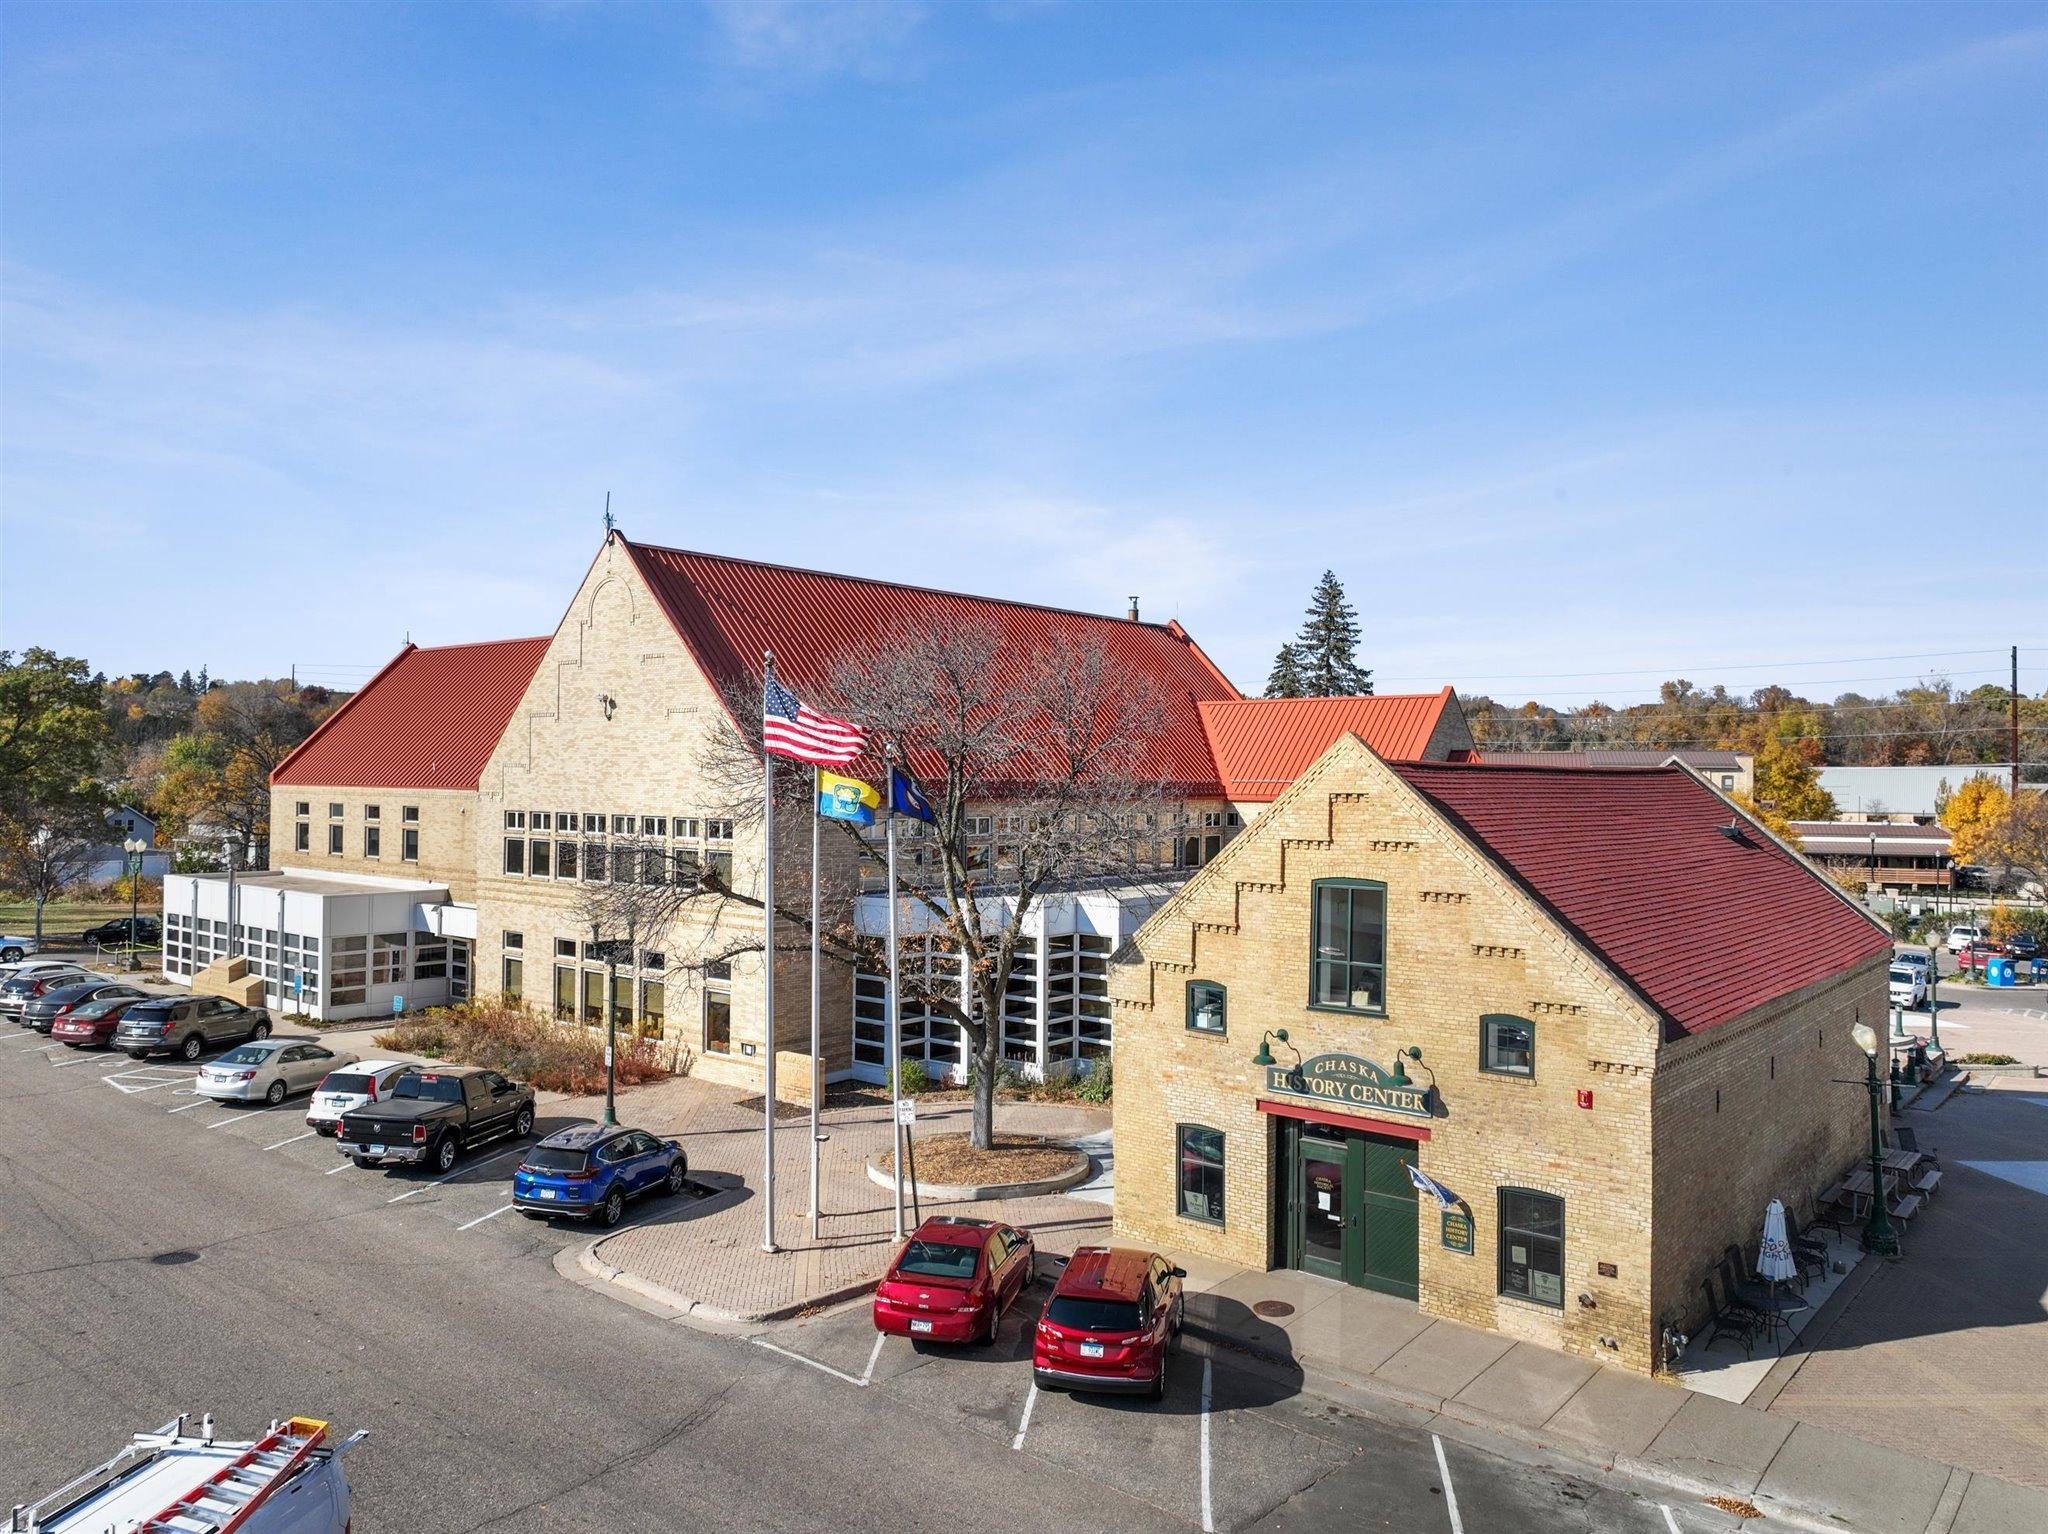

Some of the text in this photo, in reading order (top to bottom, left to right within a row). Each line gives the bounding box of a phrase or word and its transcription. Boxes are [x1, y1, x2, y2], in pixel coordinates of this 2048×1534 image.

[1315, 1060, 1379, 1083] CHASKA
[1272, 1072, 1427, 1112] HISTORY CENTER
[1446, 1220, 1467, 1230] CHASKA
[1445, 1233, 1468, 1243] CENTER
